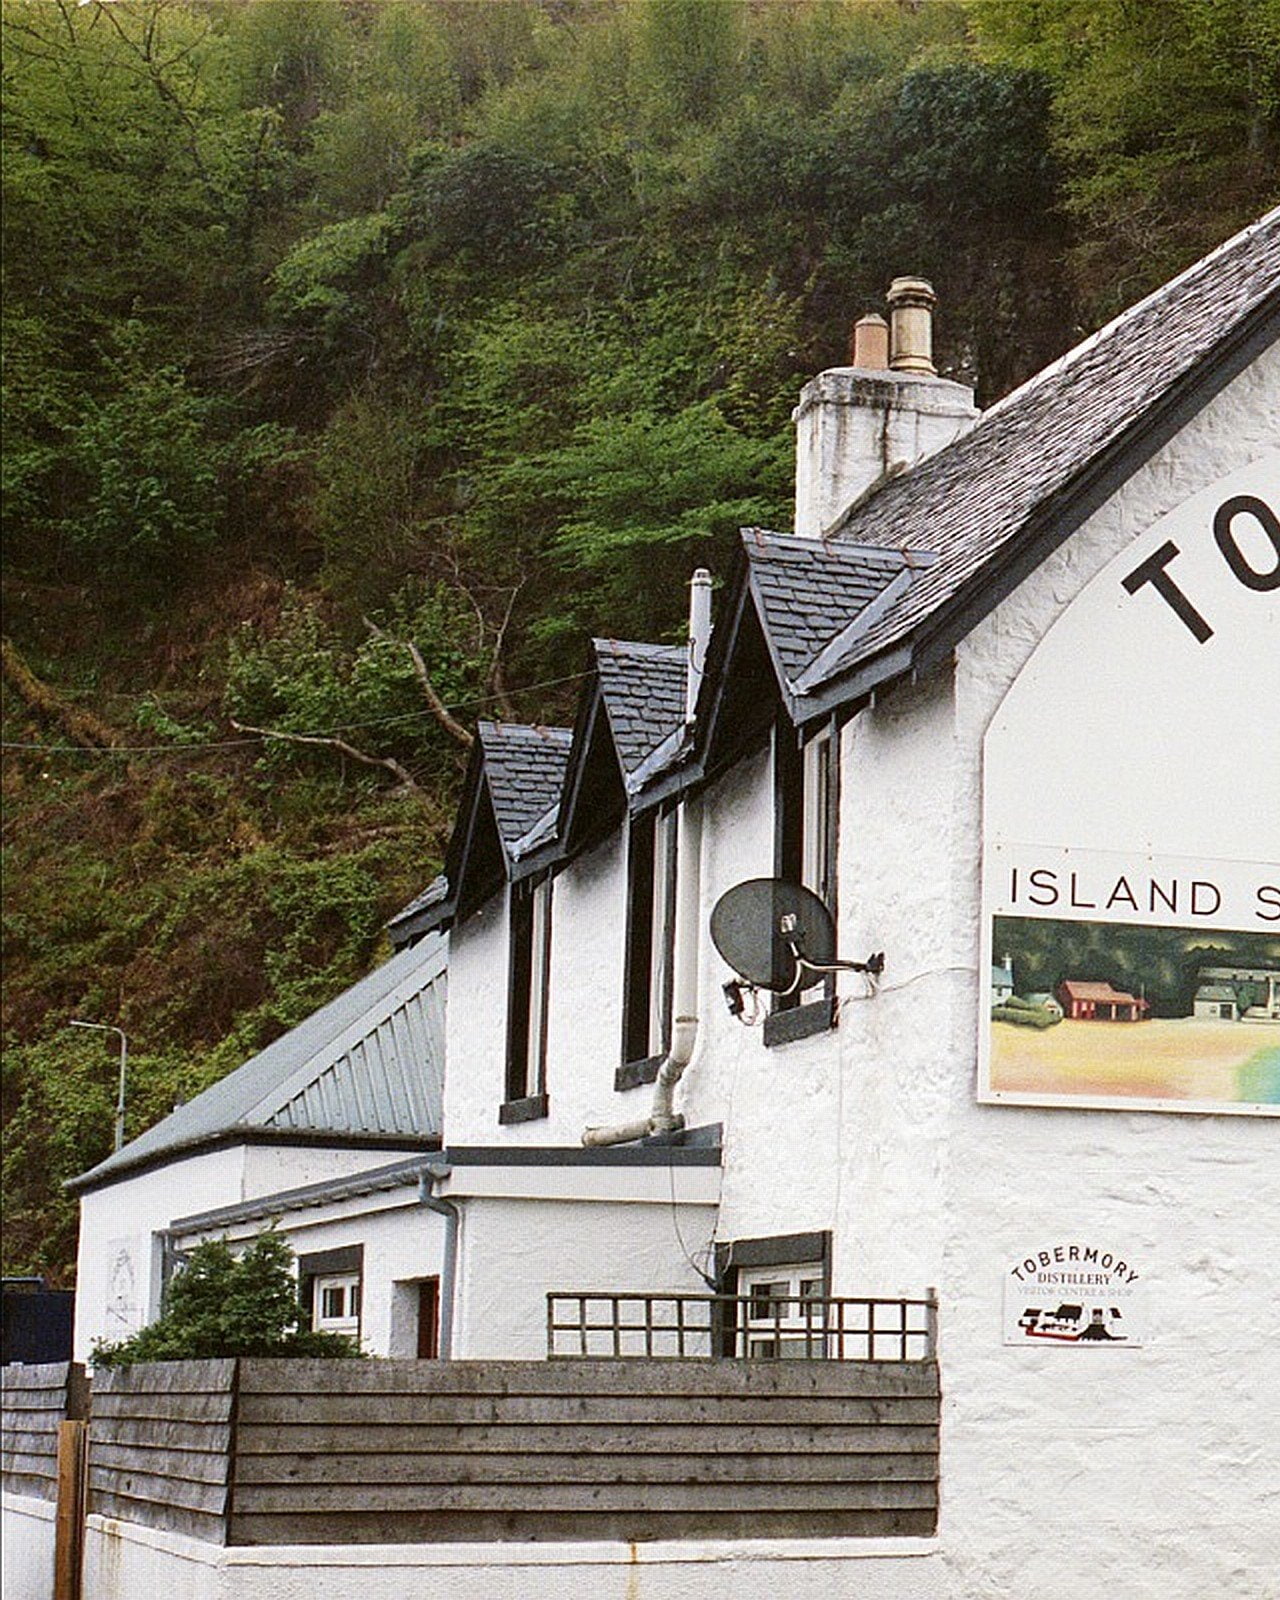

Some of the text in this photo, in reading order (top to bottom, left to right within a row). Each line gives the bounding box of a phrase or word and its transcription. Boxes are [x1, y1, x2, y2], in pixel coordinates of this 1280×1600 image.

[1011, 868, 1221, 916] ISLAND
[1011, 1246, 1139, 1284] TOBERMORY
[1037, 1272, 1111, 1285] DISTILLERY
